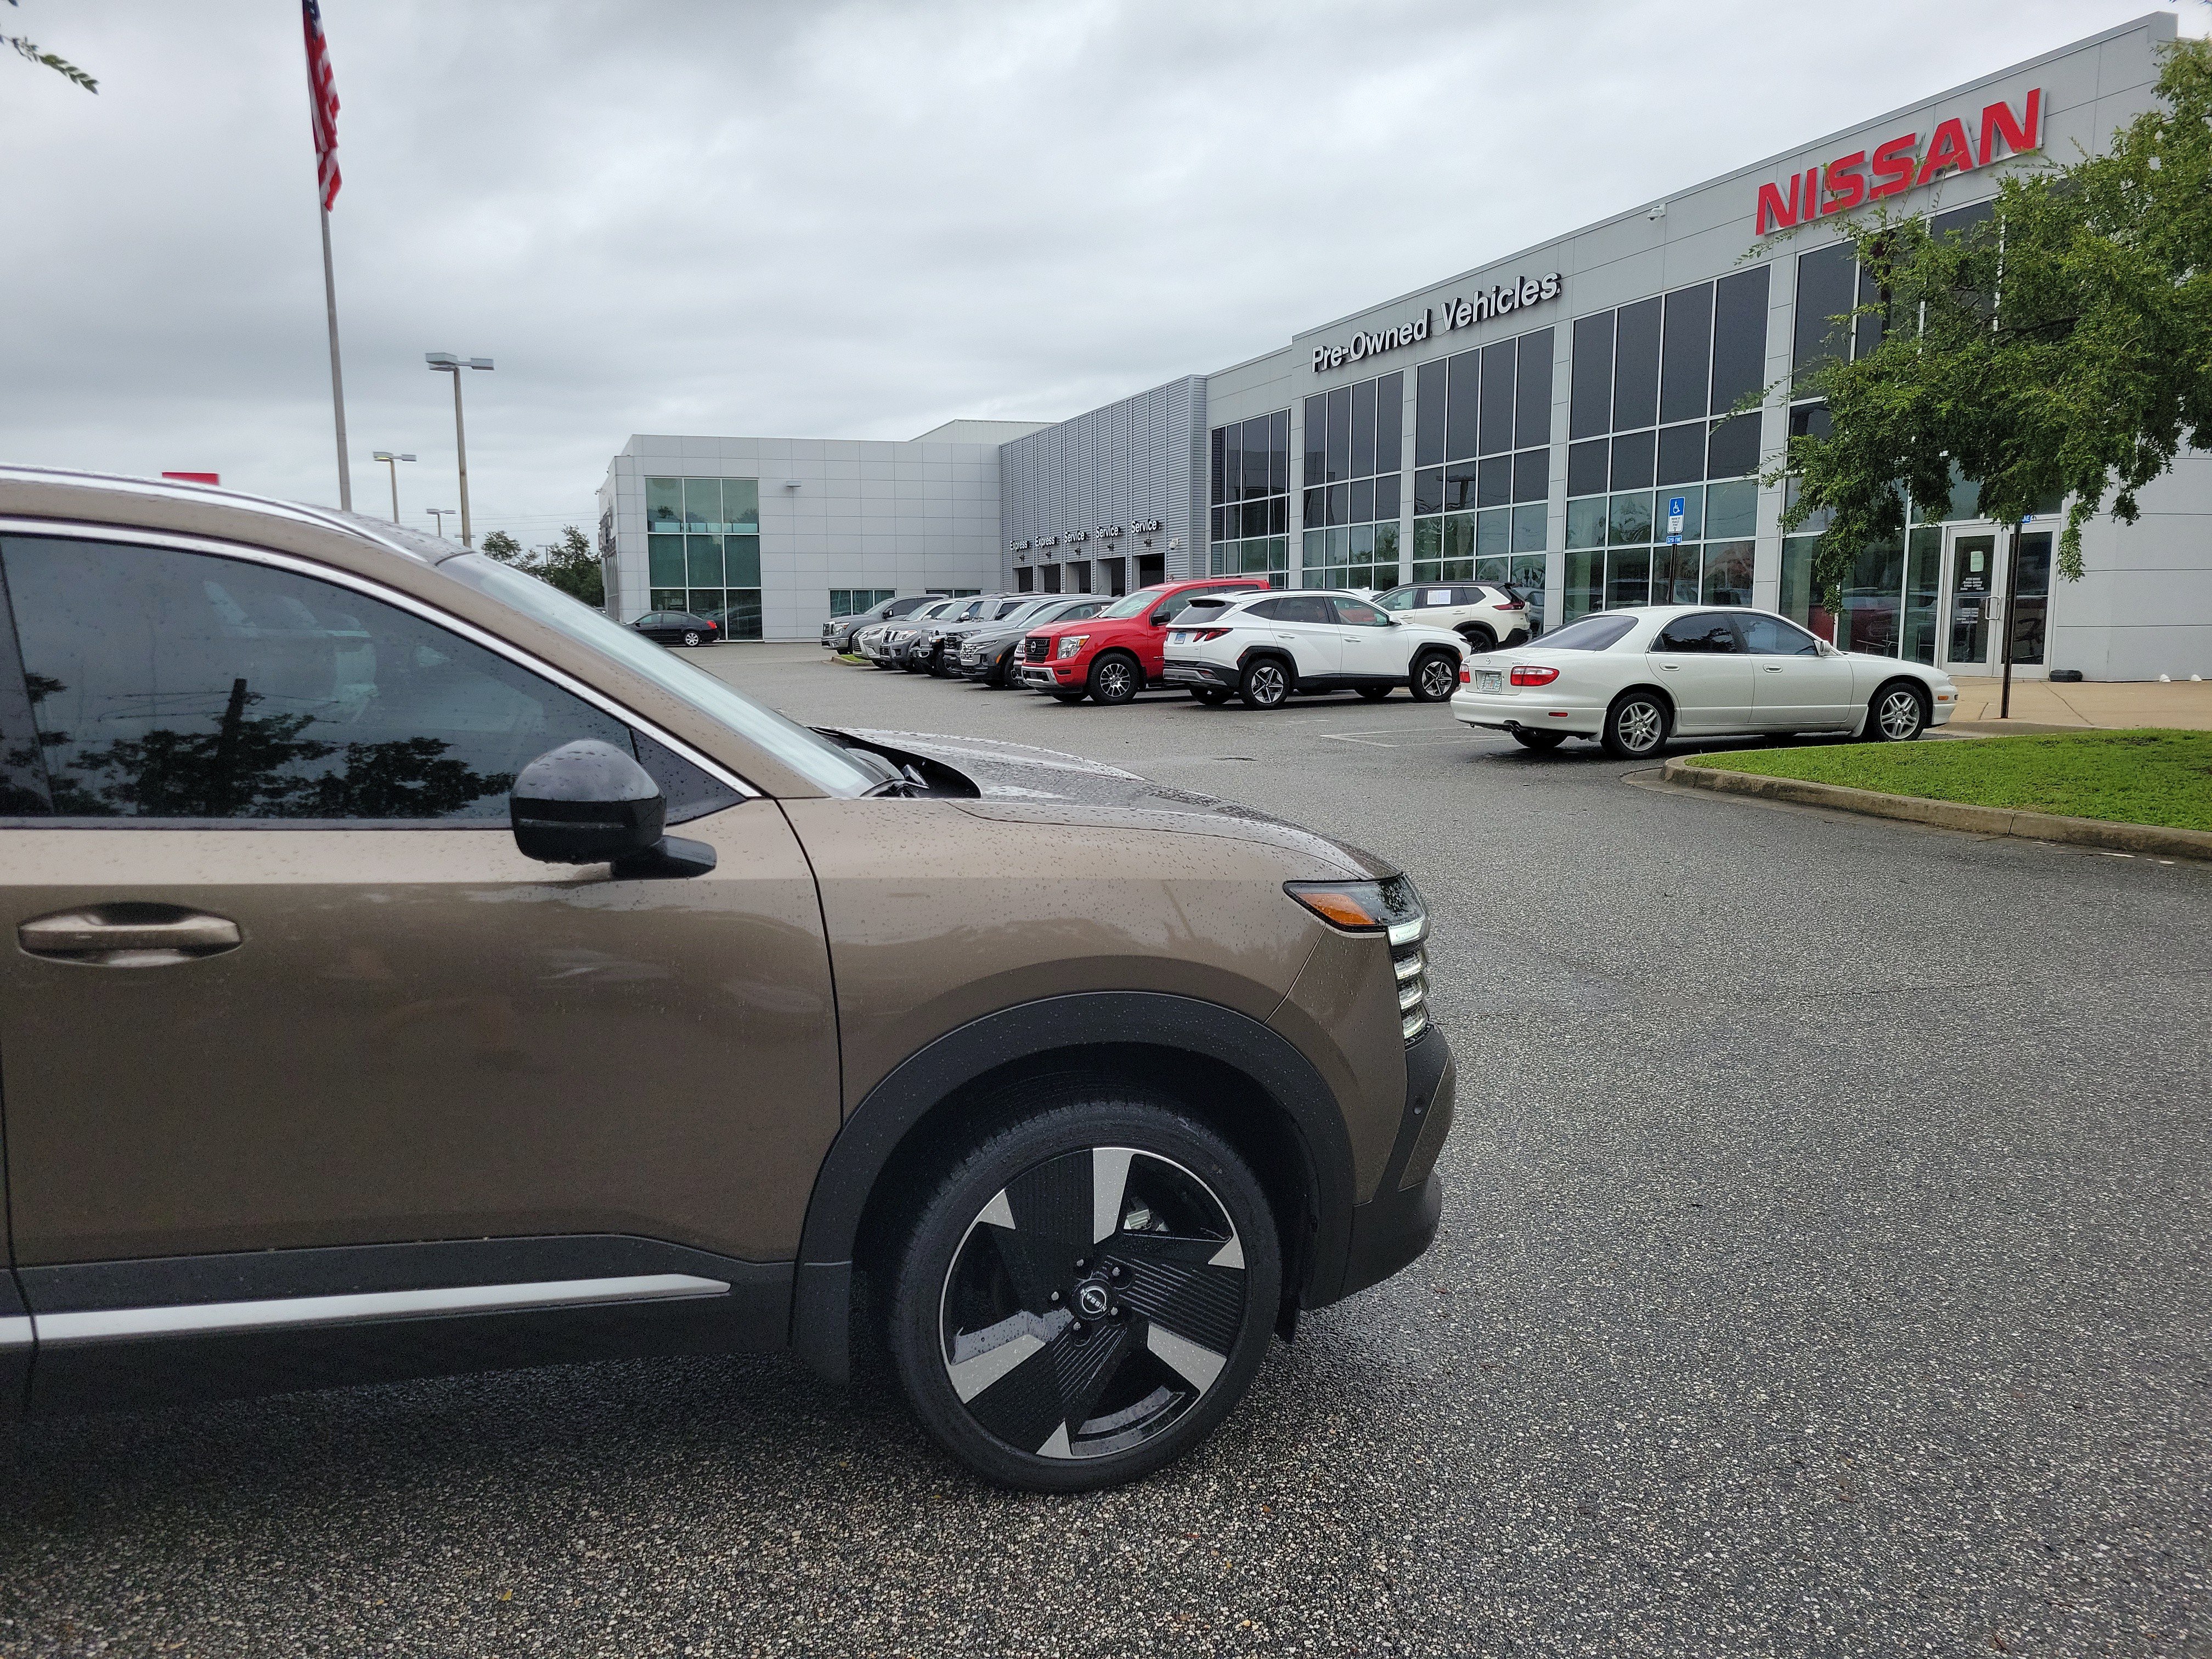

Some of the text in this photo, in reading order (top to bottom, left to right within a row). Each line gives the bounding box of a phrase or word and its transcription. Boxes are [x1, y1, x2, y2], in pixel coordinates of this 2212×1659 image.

[1756, 87, 2045, 236] NISSAN
[1311, 272, 1562, 373] Pre-Owned Vehicles
[1096, 525, 1120, 539] Service
[1131, 520, 1158, 534] Service
[1035, 536, 1056, 548] Express
[1064, 531, 1086, 543] Service
[1009, 540, 1029, 551] Express
[1080, 1289, 1107, 1312] NISSAN
